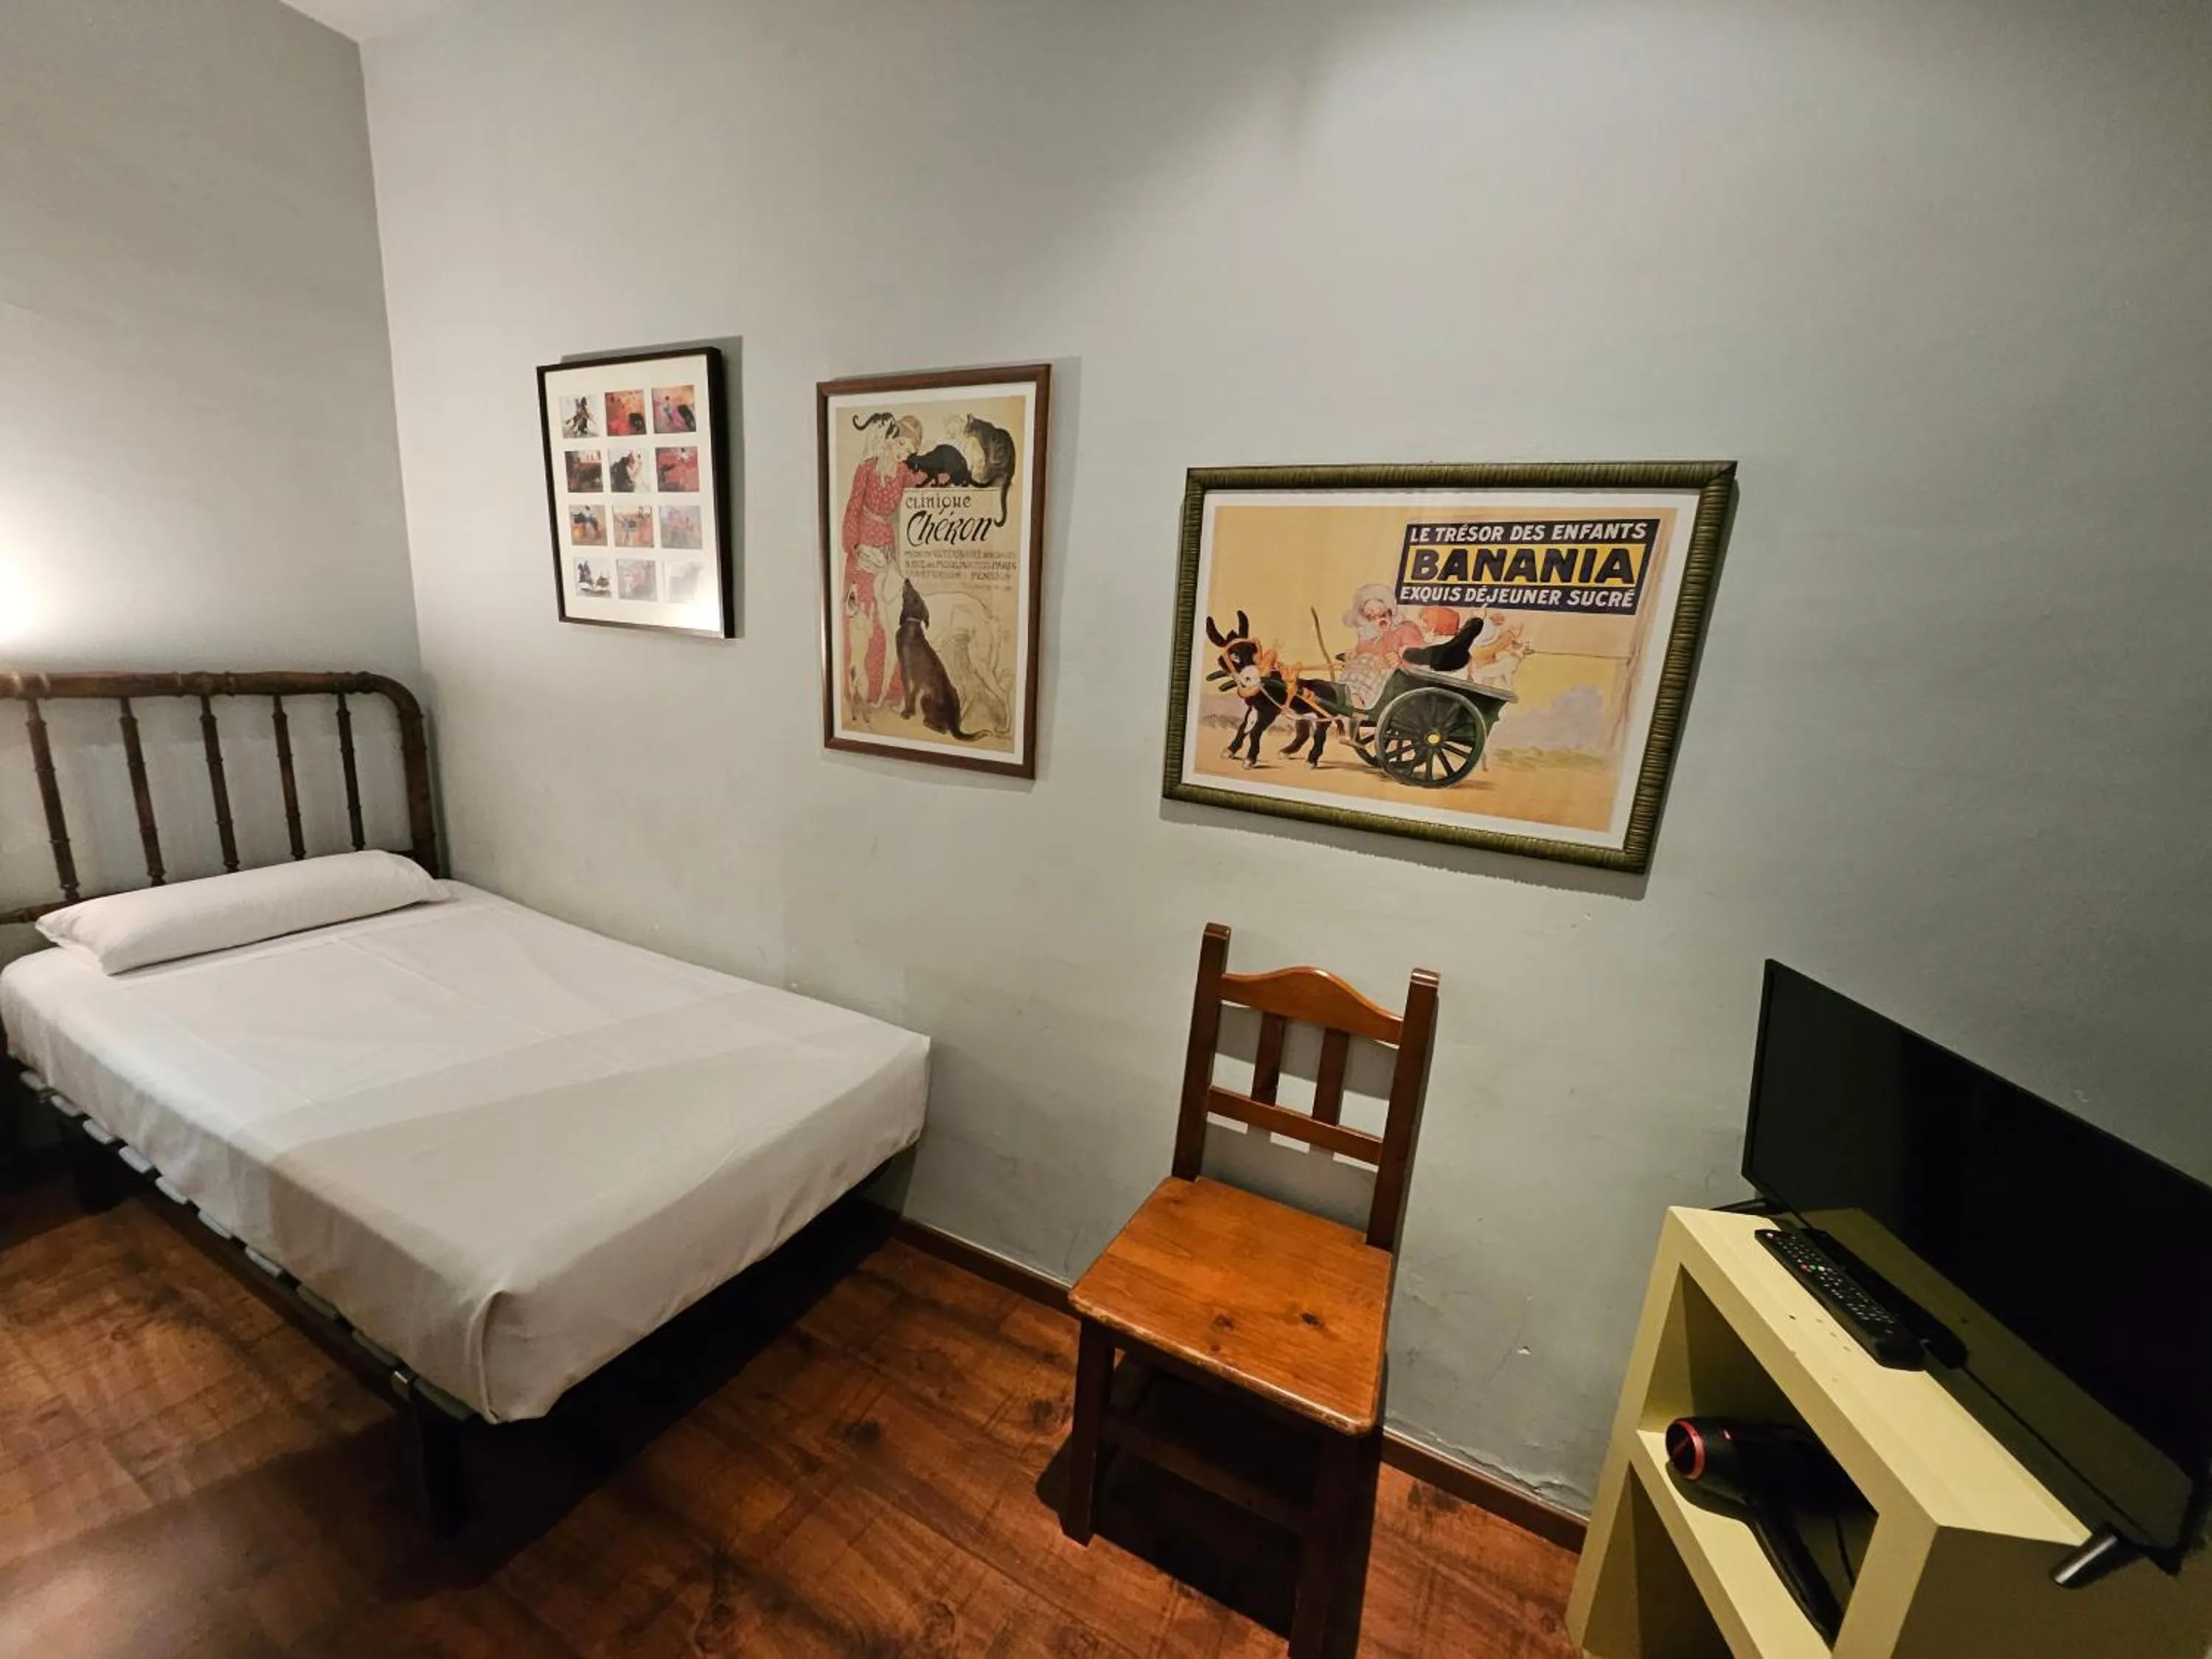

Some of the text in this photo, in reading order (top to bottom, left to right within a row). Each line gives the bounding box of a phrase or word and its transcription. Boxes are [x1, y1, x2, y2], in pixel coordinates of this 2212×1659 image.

[1409, 522, 1649, 543] LE TRÉSOR DES ENFANTS
[1411, 548, 1635, 582] BANANIA
[1400, 585, 1636, 608] EXQUIS DÉJEUNER SUCRÉ
